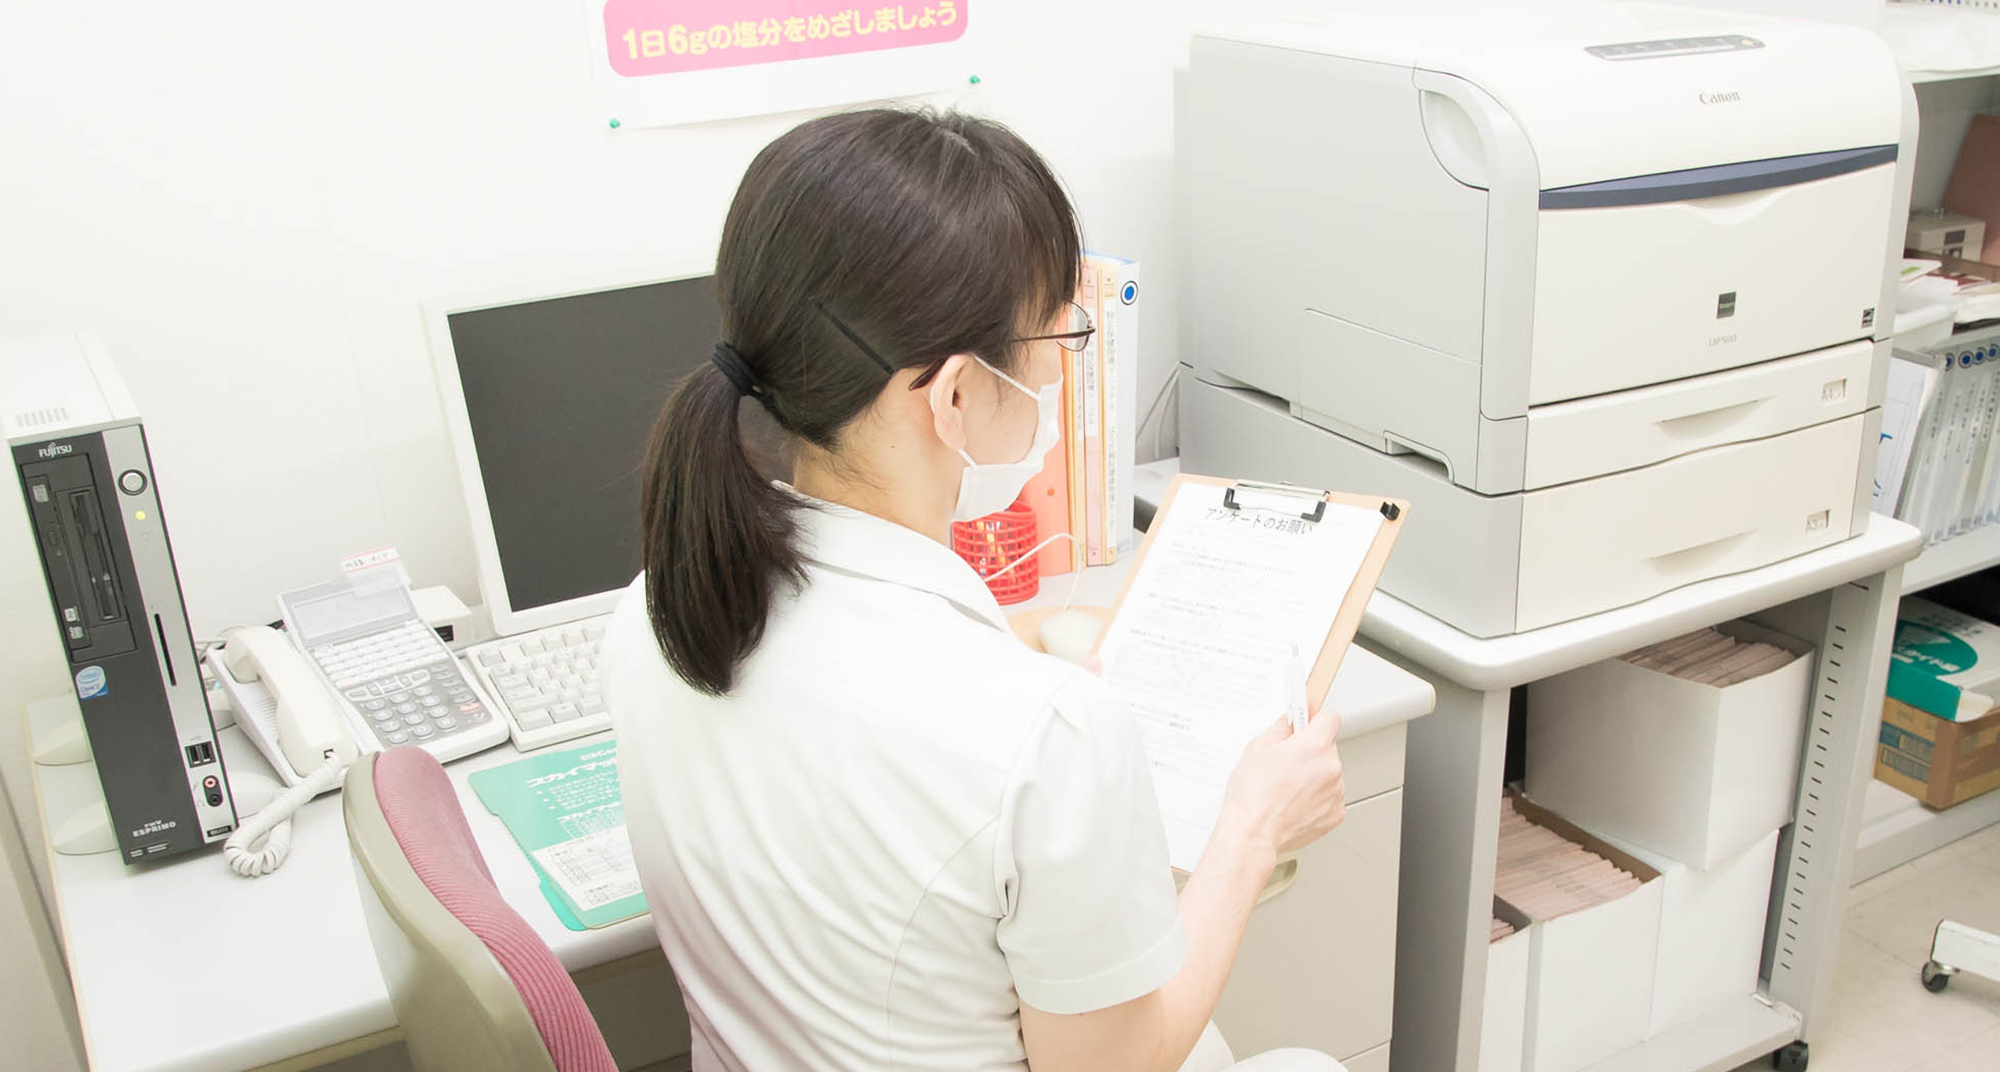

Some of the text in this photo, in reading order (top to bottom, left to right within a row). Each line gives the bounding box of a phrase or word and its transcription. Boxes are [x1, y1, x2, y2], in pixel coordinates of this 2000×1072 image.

[622, 1, 957, 60] 1日6gの塩分をめざしましょう
[1699, 91, 1741, 105] Canon
[39, 442, 72, 458] FUJITSU
[1205, 507, 1312, 535] アンケートのお願い
[132, 821, 176, 838] ESPRIMO
